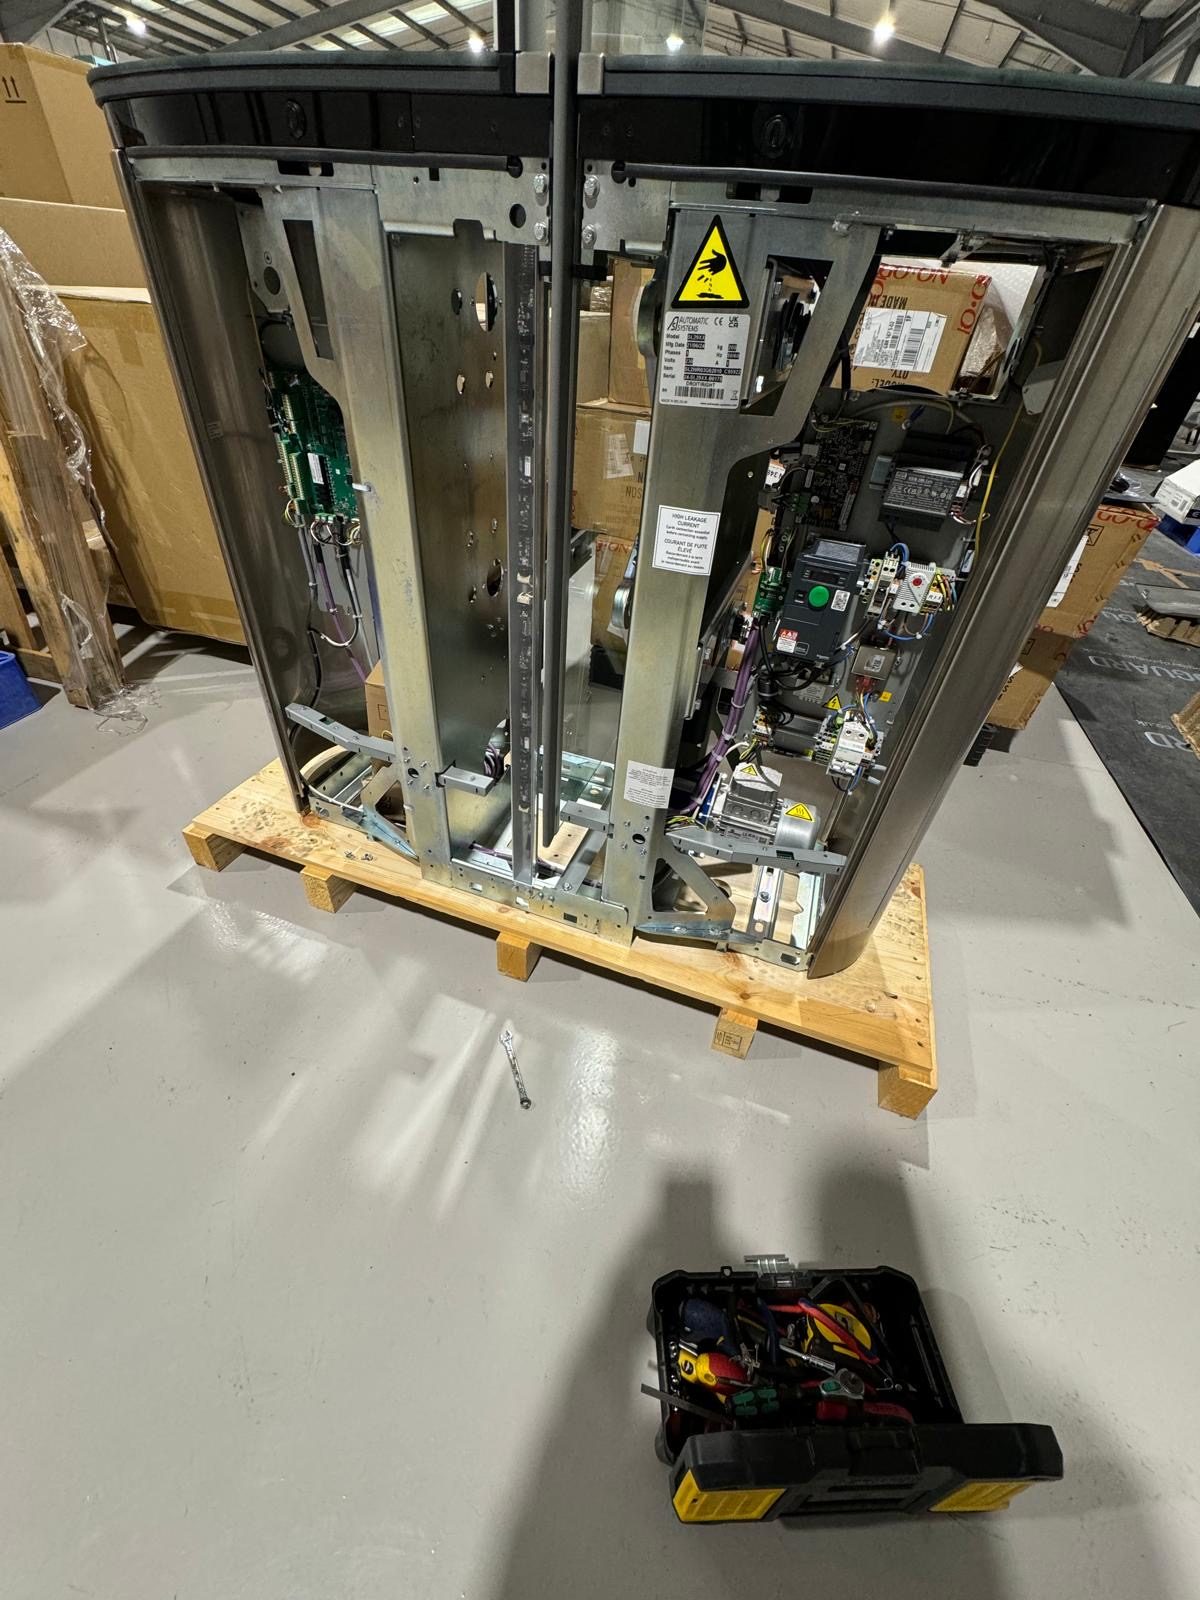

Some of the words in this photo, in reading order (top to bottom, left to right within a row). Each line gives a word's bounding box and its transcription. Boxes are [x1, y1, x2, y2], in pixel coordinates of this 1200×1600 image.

[680, 316, 709, 325] AUTOMATIC
[677, 324, 699, 332] SYSTEMS
[664, 538, 686, 546] COURANT
[1144, 731, 1194, 752] RD
